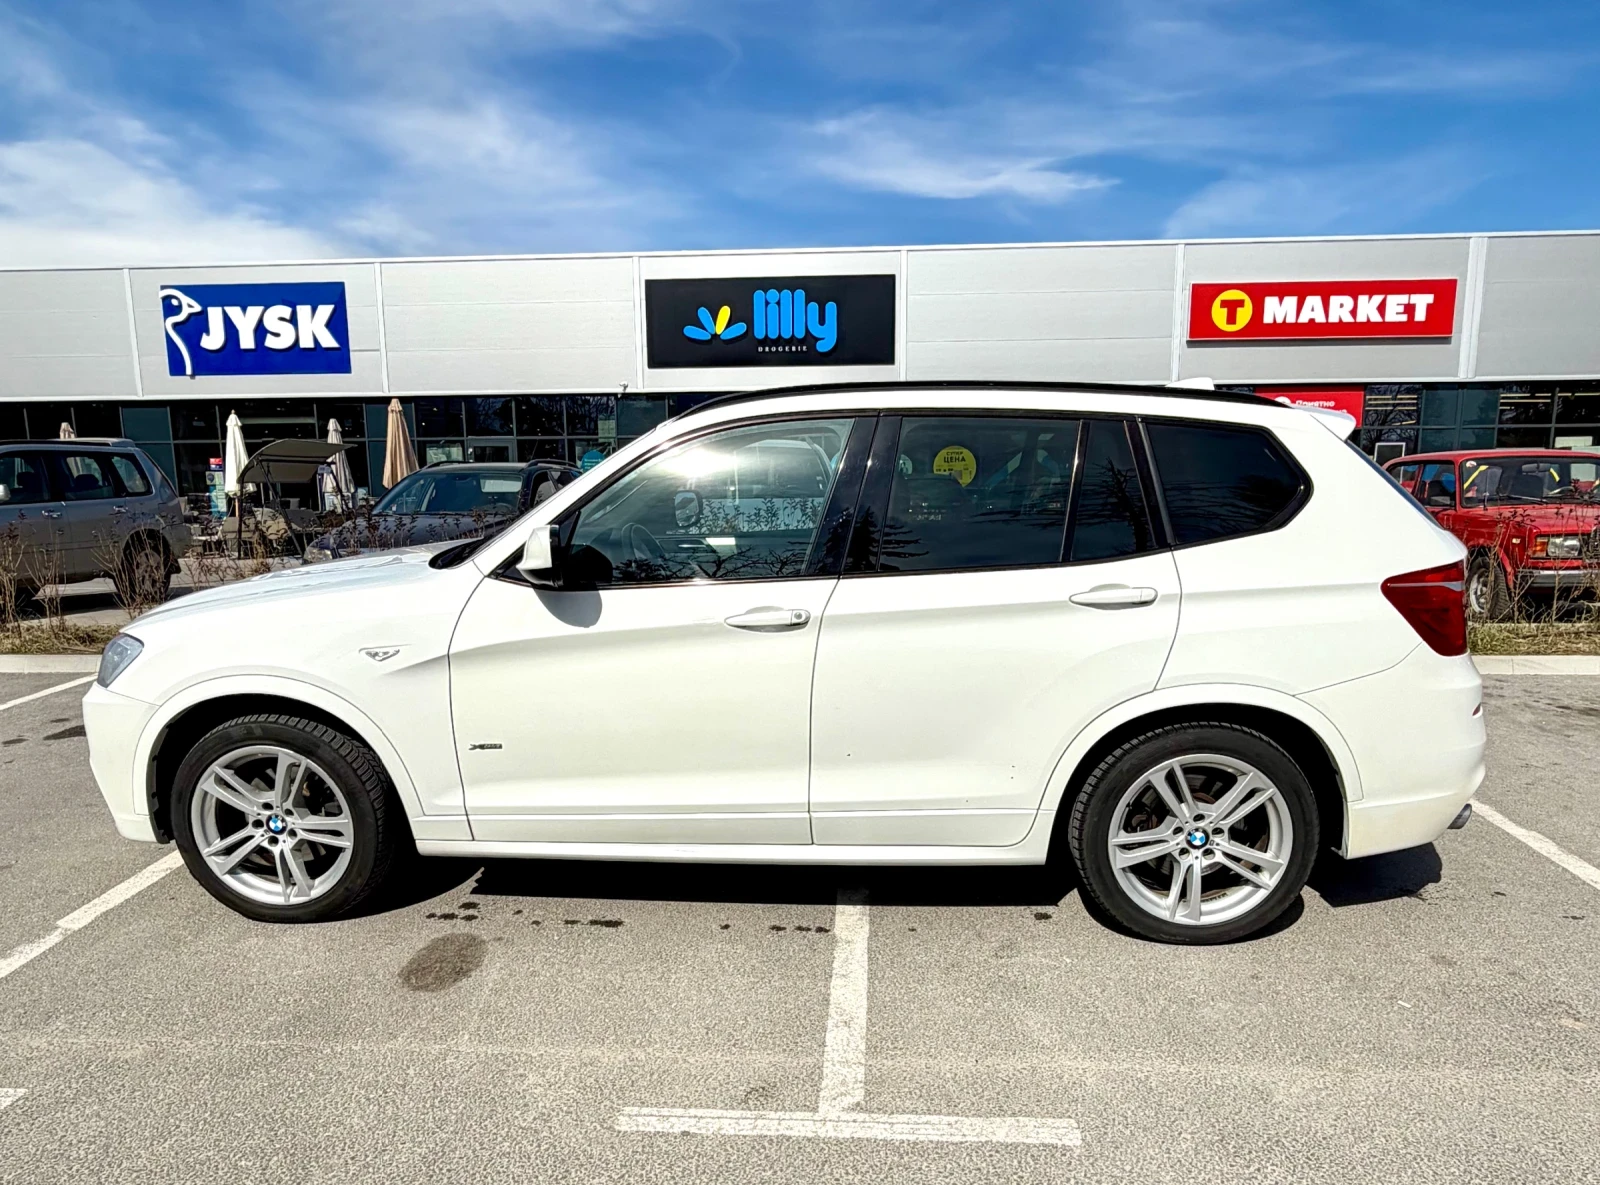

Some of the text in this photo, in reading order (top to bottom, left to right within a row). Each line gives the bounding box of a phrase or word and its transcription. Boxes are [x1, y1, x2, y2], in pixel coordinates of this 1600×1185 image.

[200, 304, 341, 351] JYSK
[753, 289, 837, 352] lilly
[1220, 294, 1434, 325] T MARKET
